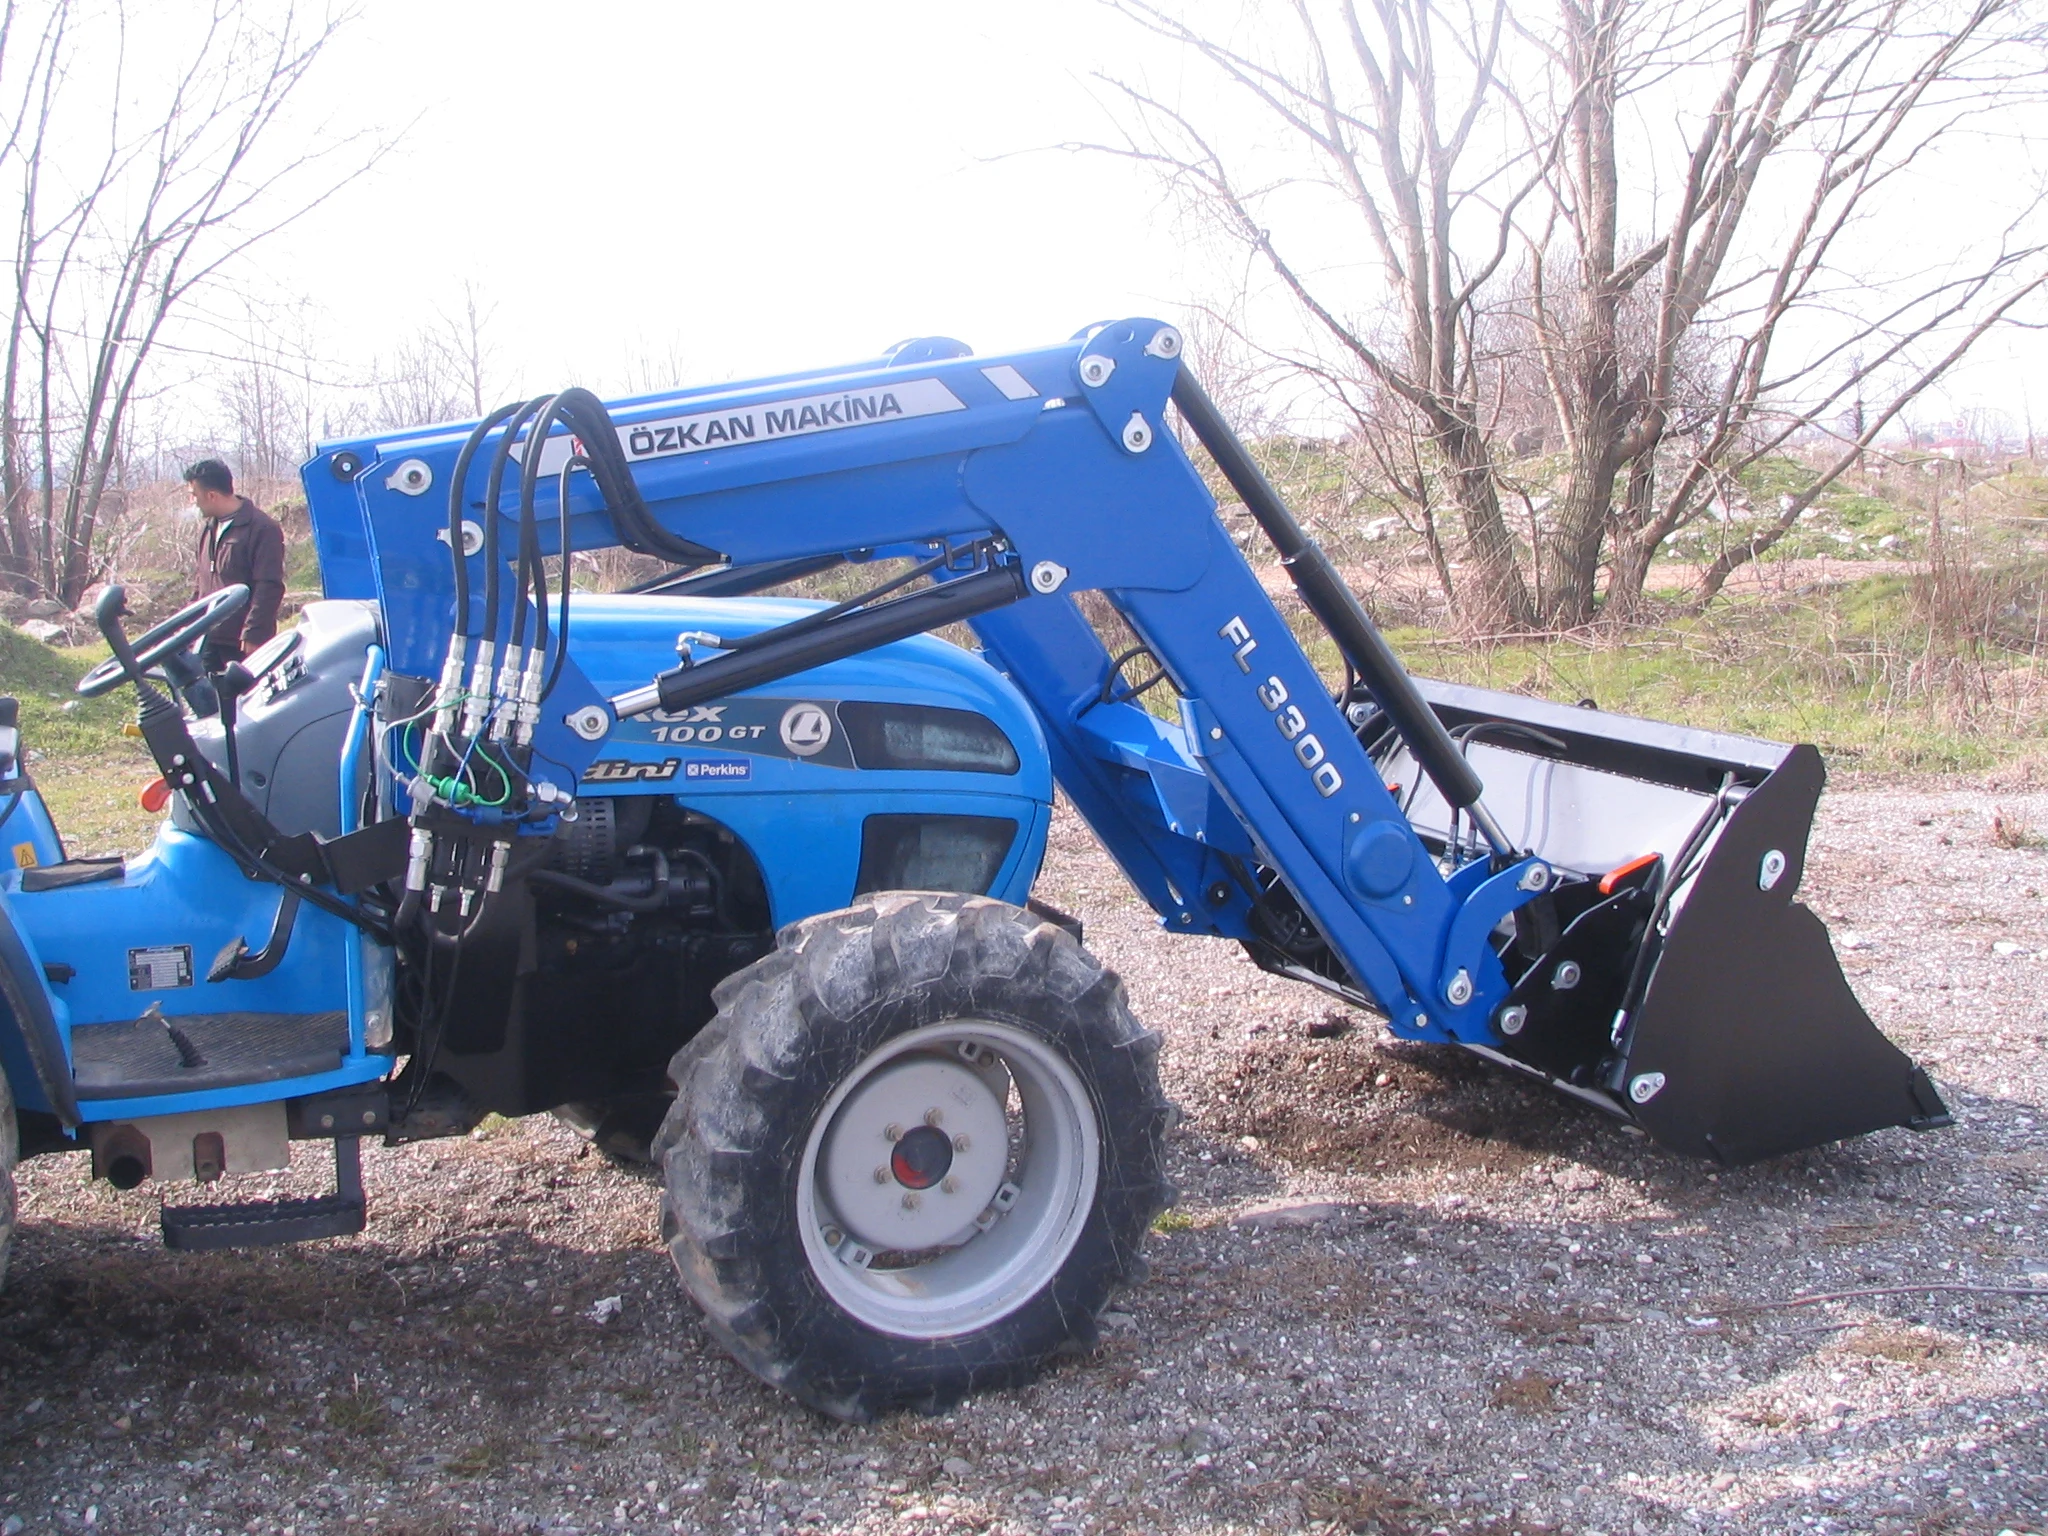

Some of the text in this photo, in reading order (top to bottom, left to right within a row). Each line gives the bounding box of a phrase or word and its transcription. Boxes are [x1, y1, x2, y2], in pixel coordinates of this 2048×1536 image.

[629, 393, 904, 456] ÖZKAN MAKİNA
[1217, 615, 1344, 799] FL 3300
[651, 725, 766, 742] 100 GT
[700, 763, 748, 776] Perkins
